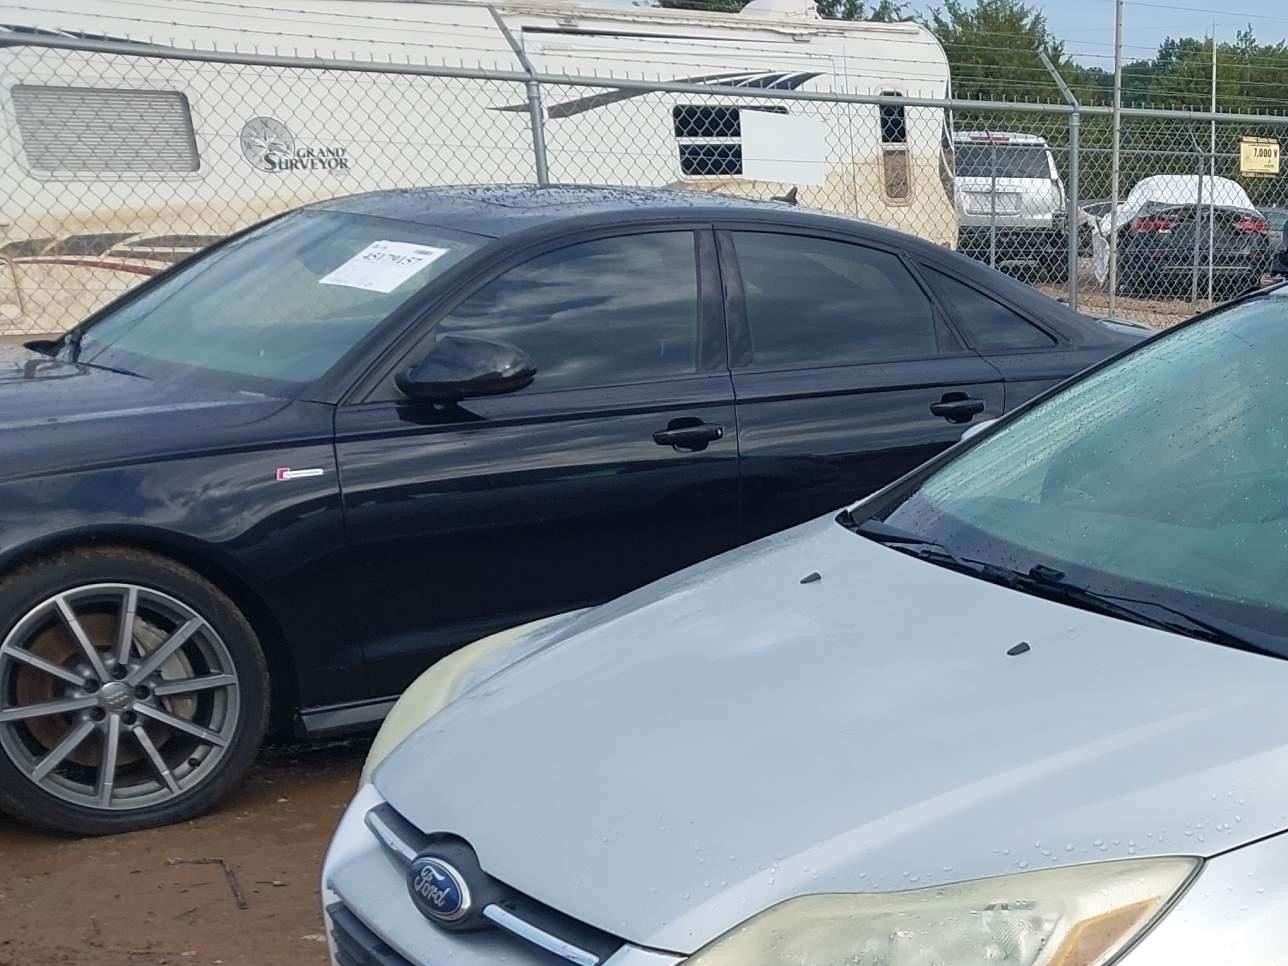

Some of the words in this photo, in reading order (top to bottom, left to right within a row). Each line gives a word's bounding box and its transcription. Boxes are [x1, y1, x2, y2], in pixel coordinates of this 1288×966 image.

[296, 147, 346, 158] GRAND
[1253, 147, 1272, 158] 7,000
[1273, 149, 1278, 159] V
[263, 152, 351, 171] SURVEYOR
[414, 865, 452, 908] Ford
